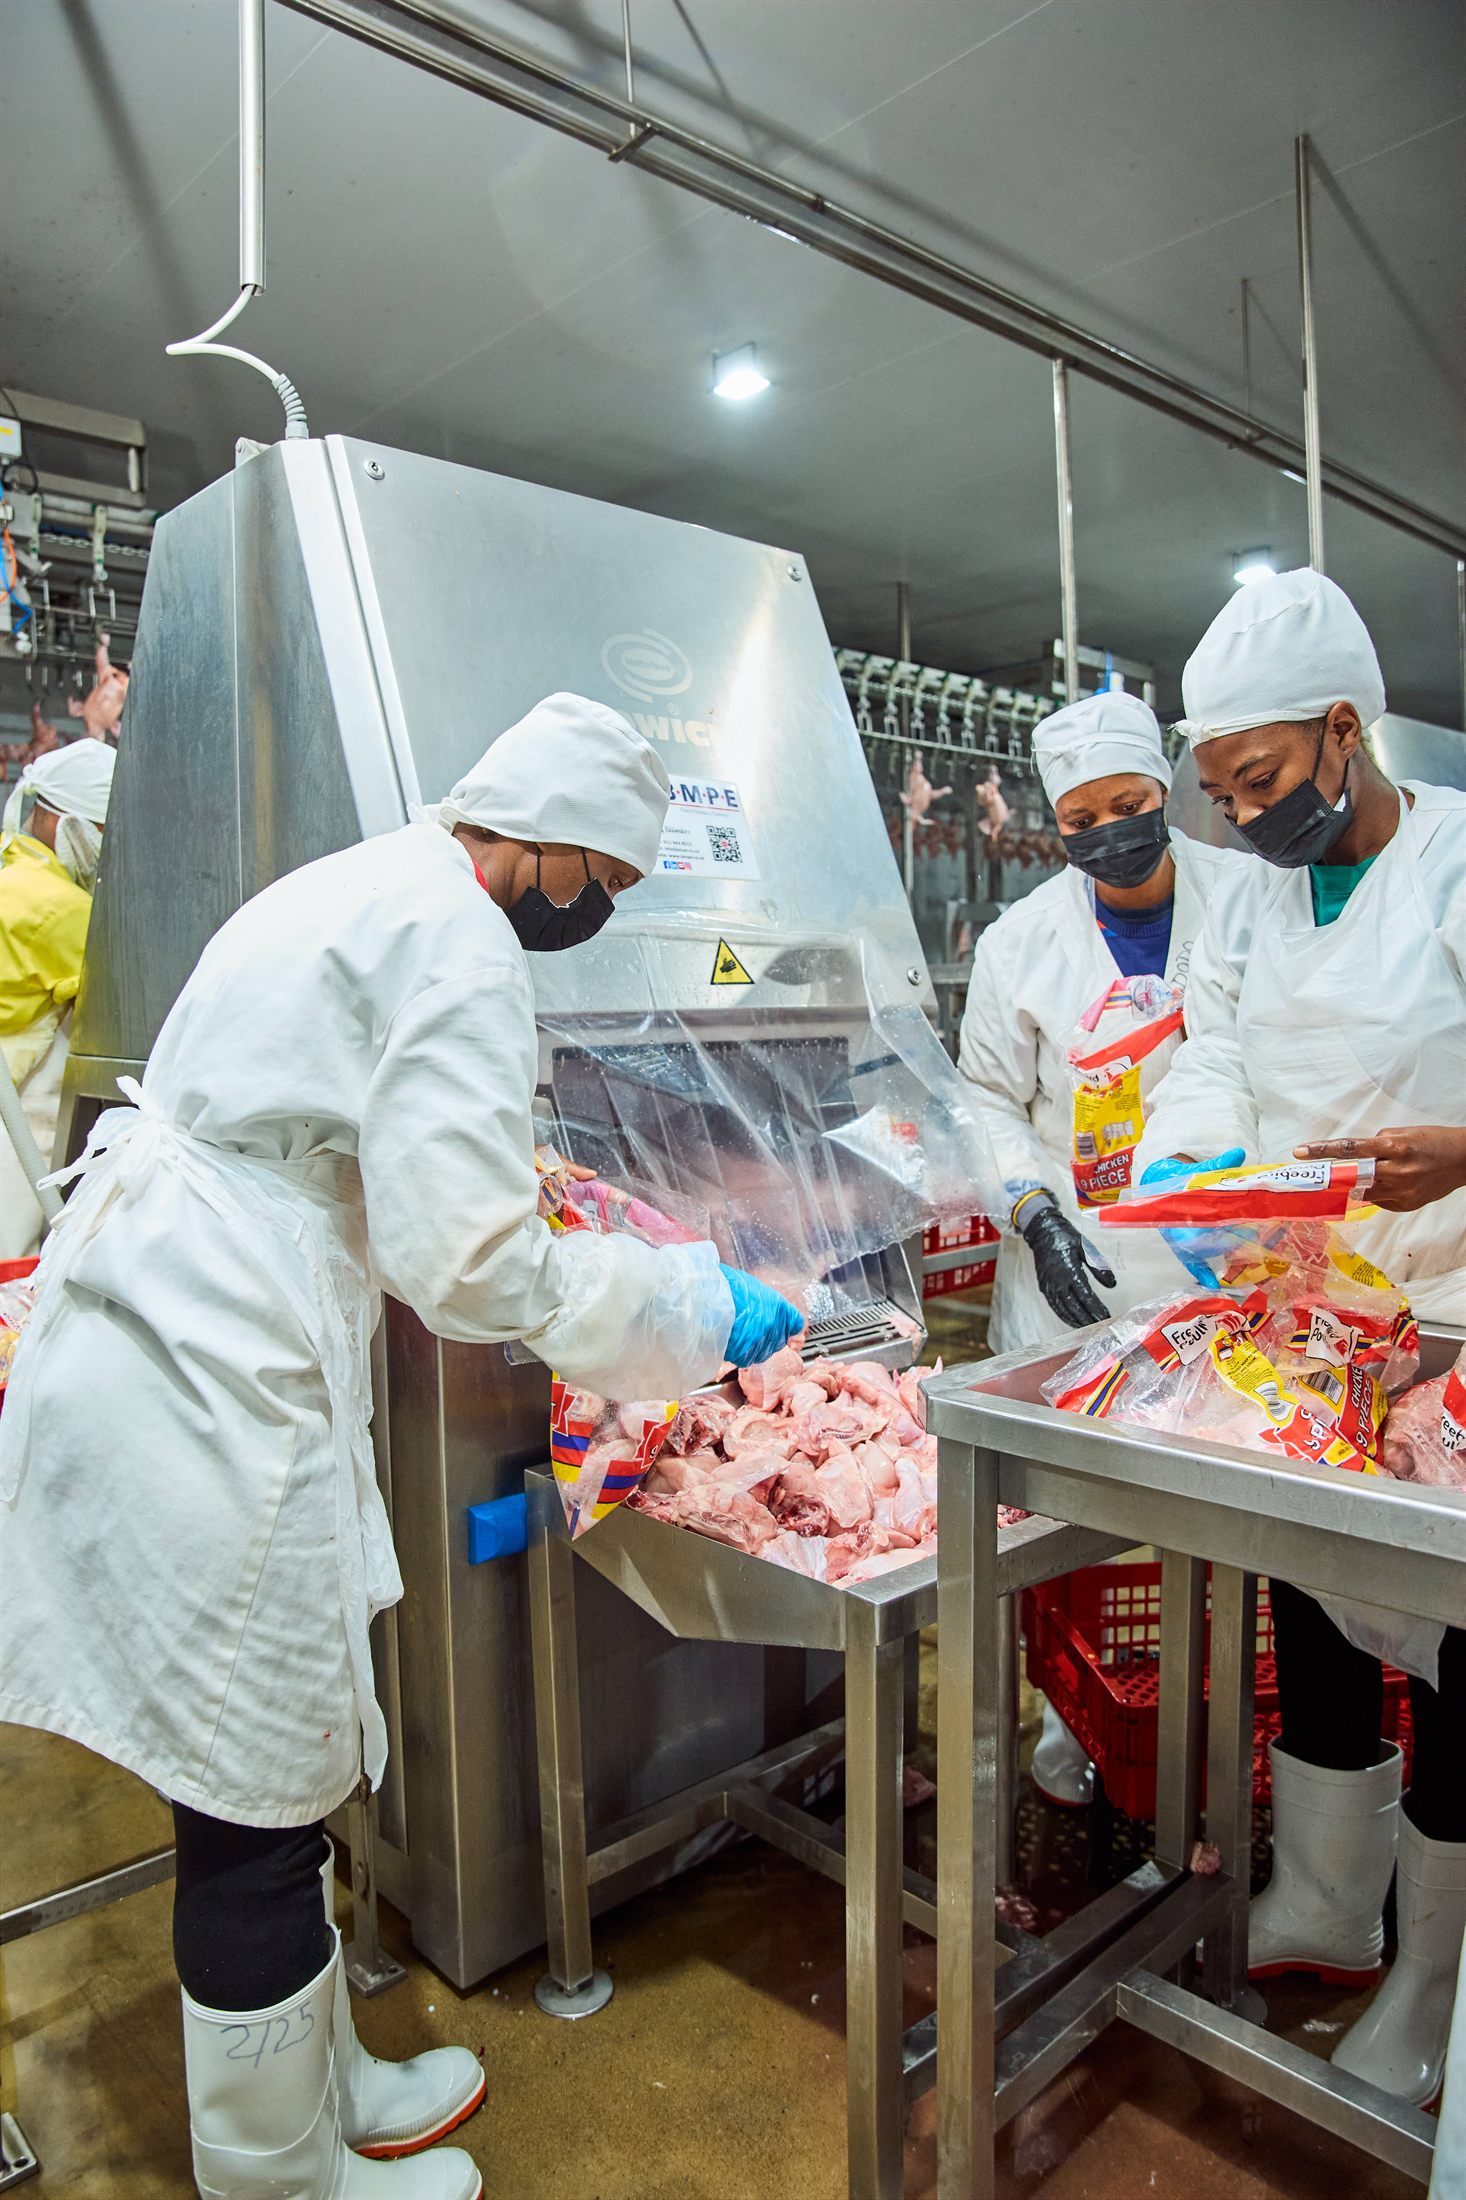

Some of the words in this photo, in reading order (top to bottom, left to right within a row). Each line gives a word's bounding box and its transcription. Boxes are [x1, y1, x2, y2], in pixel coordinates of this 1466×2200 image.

[617, 709, 719, 747] WIC
[1080, 1178, 1088, 1190] 9
[1089, 1168, 1127, 1190] PIECE
[1352, 1366, 1363, 1408] CHICKE
[1355, 1431, 1368, 1448] 9
